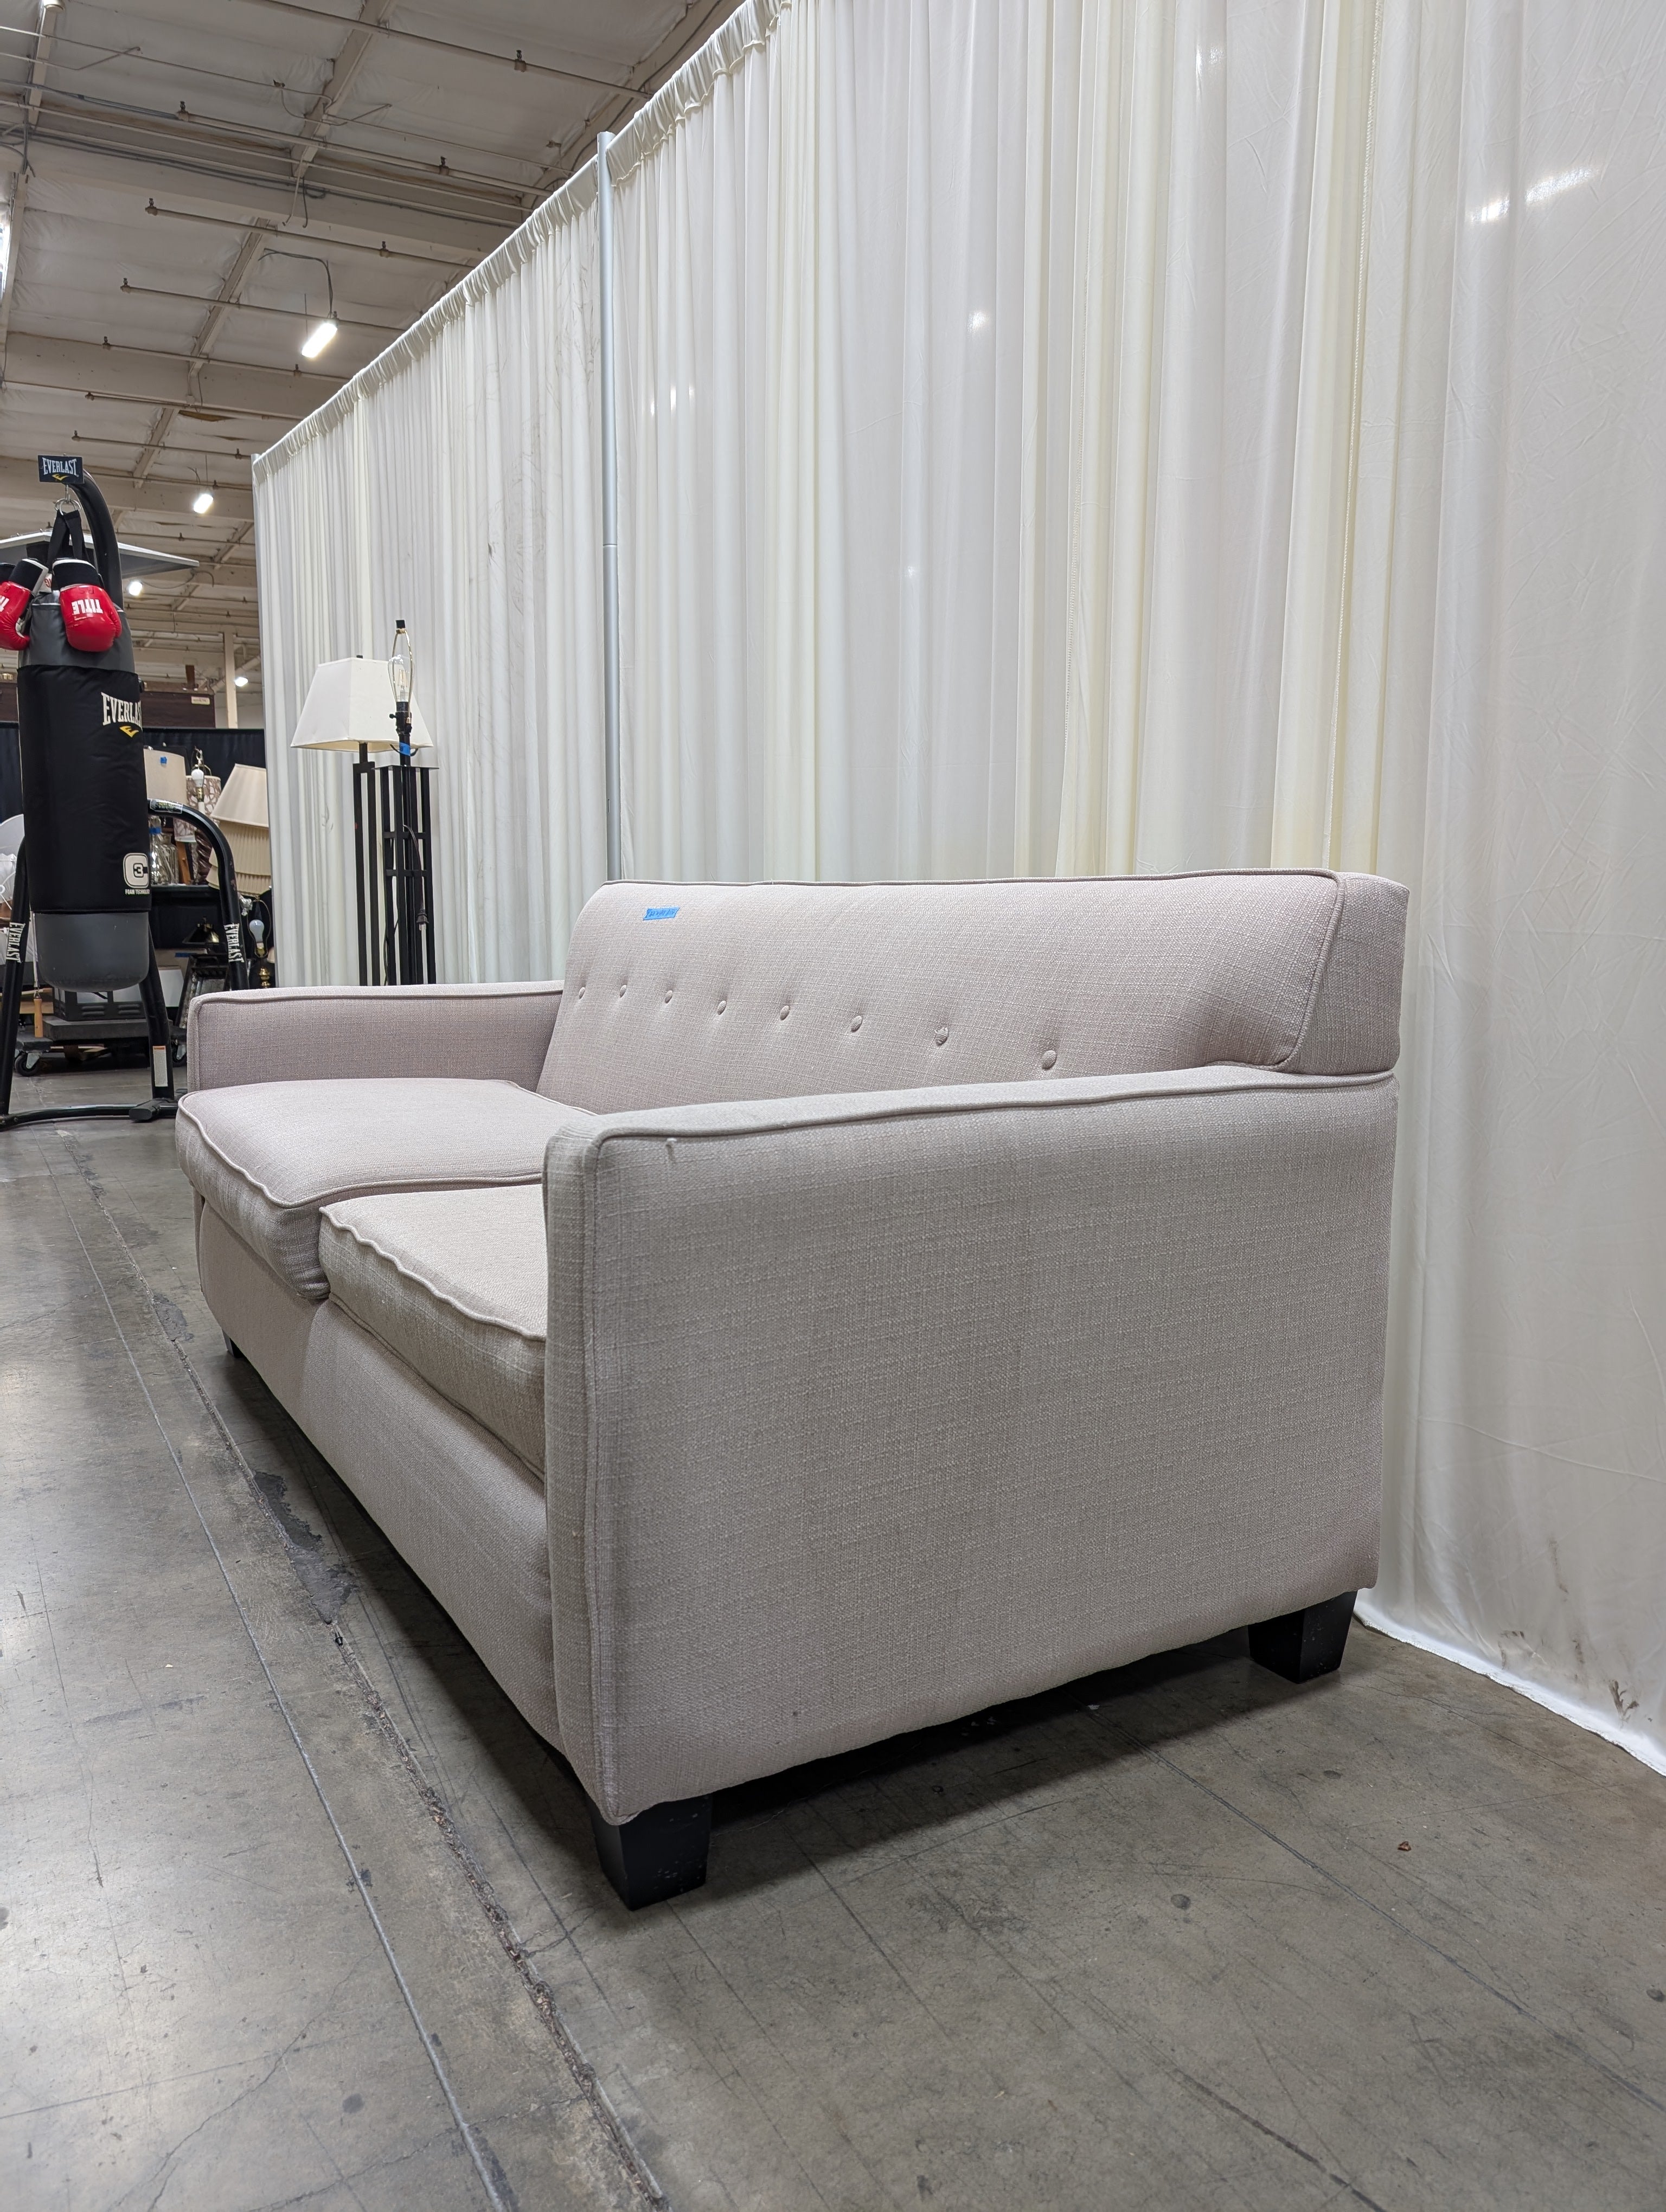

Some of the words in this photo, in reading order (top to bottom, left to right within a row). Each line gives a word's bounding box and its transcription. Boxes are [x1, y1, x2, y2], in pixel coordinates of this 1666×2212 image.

[42, 457, 77, 476] EVERLAST
[71, 599, 104, 615] TITLE
[101, 691, 143, 732] EVERLAS
[6, 922, 26, 963] EVERLAST
[223, 923, 245, 963] EVERLAST
